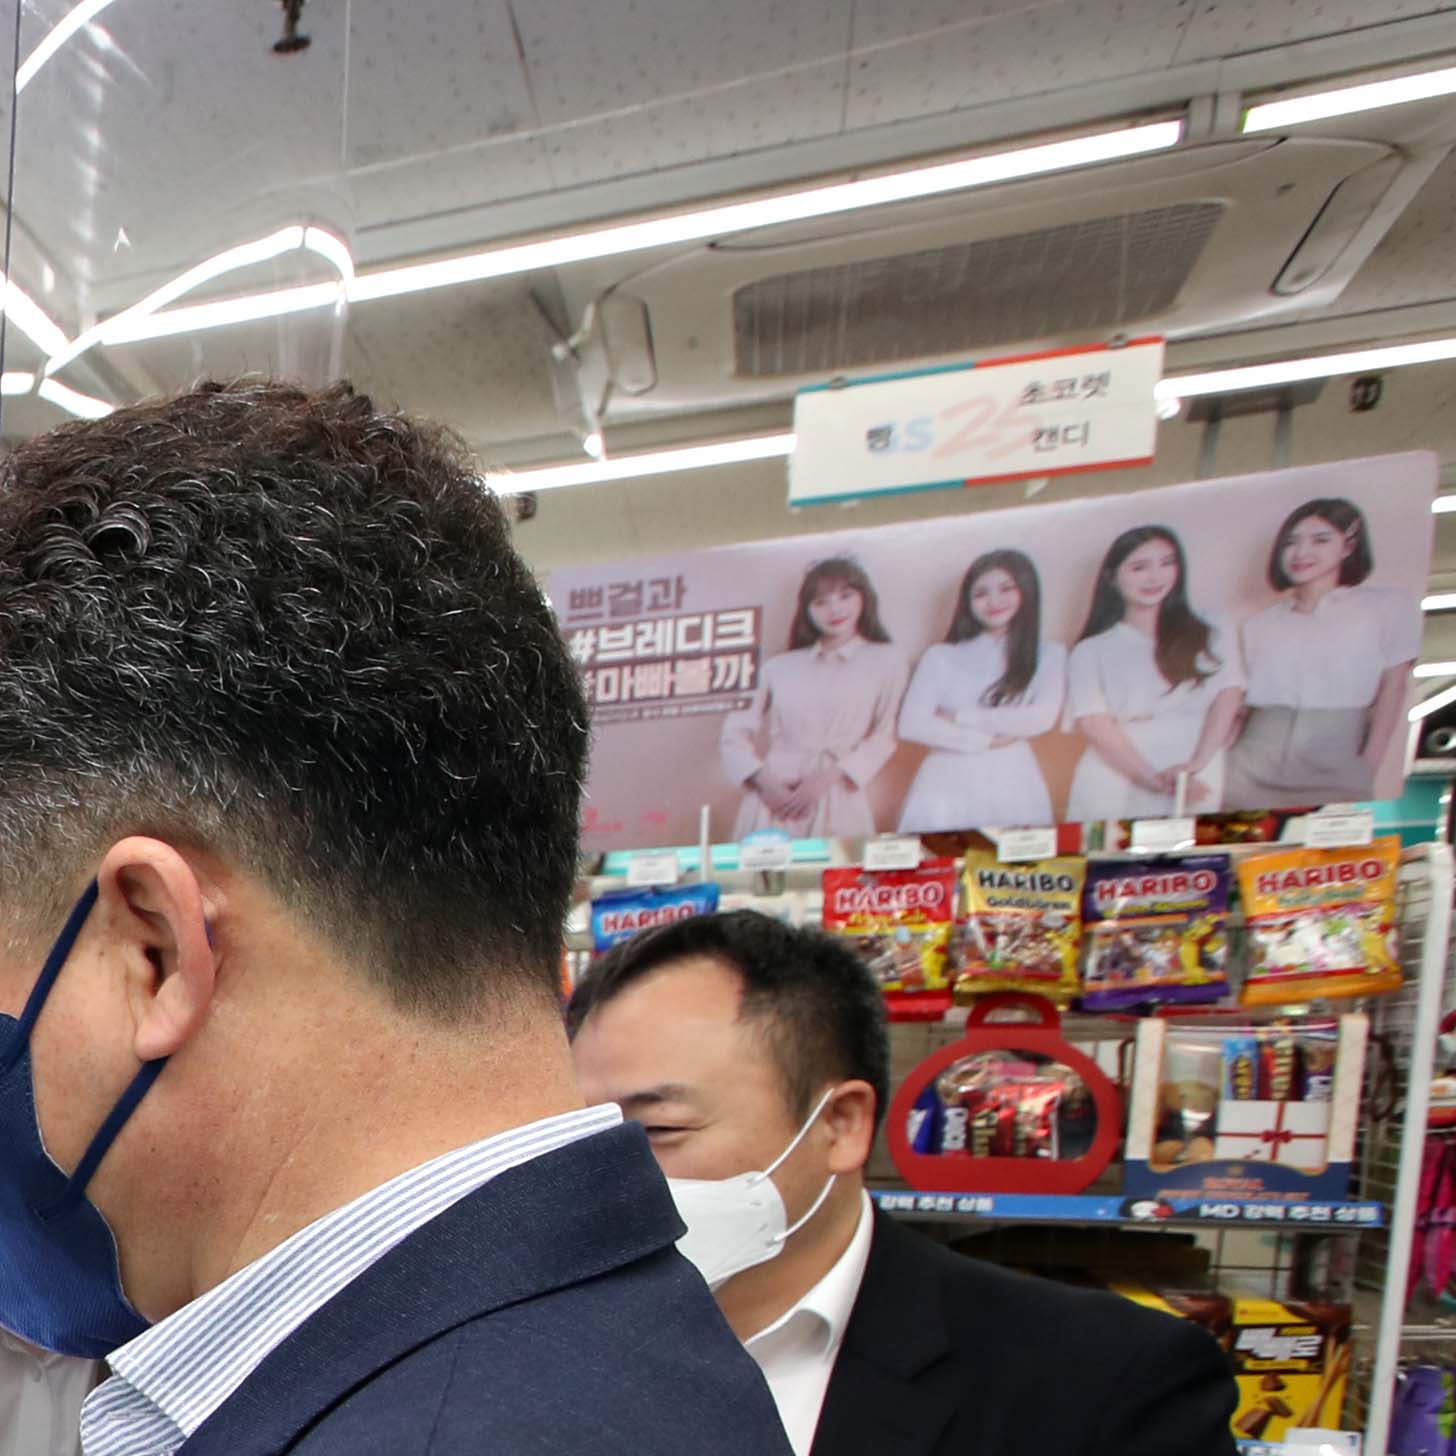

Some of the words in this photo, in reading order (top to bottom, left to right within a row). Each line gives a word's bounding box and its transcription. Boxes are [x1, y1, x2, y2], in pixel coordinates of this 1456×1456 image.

[1032, 420, 1091, 453] 캔디
[568, 609, 757, 665] #브레디크
[977, 868, 1077, 893] HARIBO
[1095, 869, 1219, 902] HARIBO
[1255, 858, 1385, 895] HARIBO
[834, 881, 947, 914] HARIBO
[602, 903, 697, 935] HARIBO
[1199, 1204, 1239, 1220] MD
